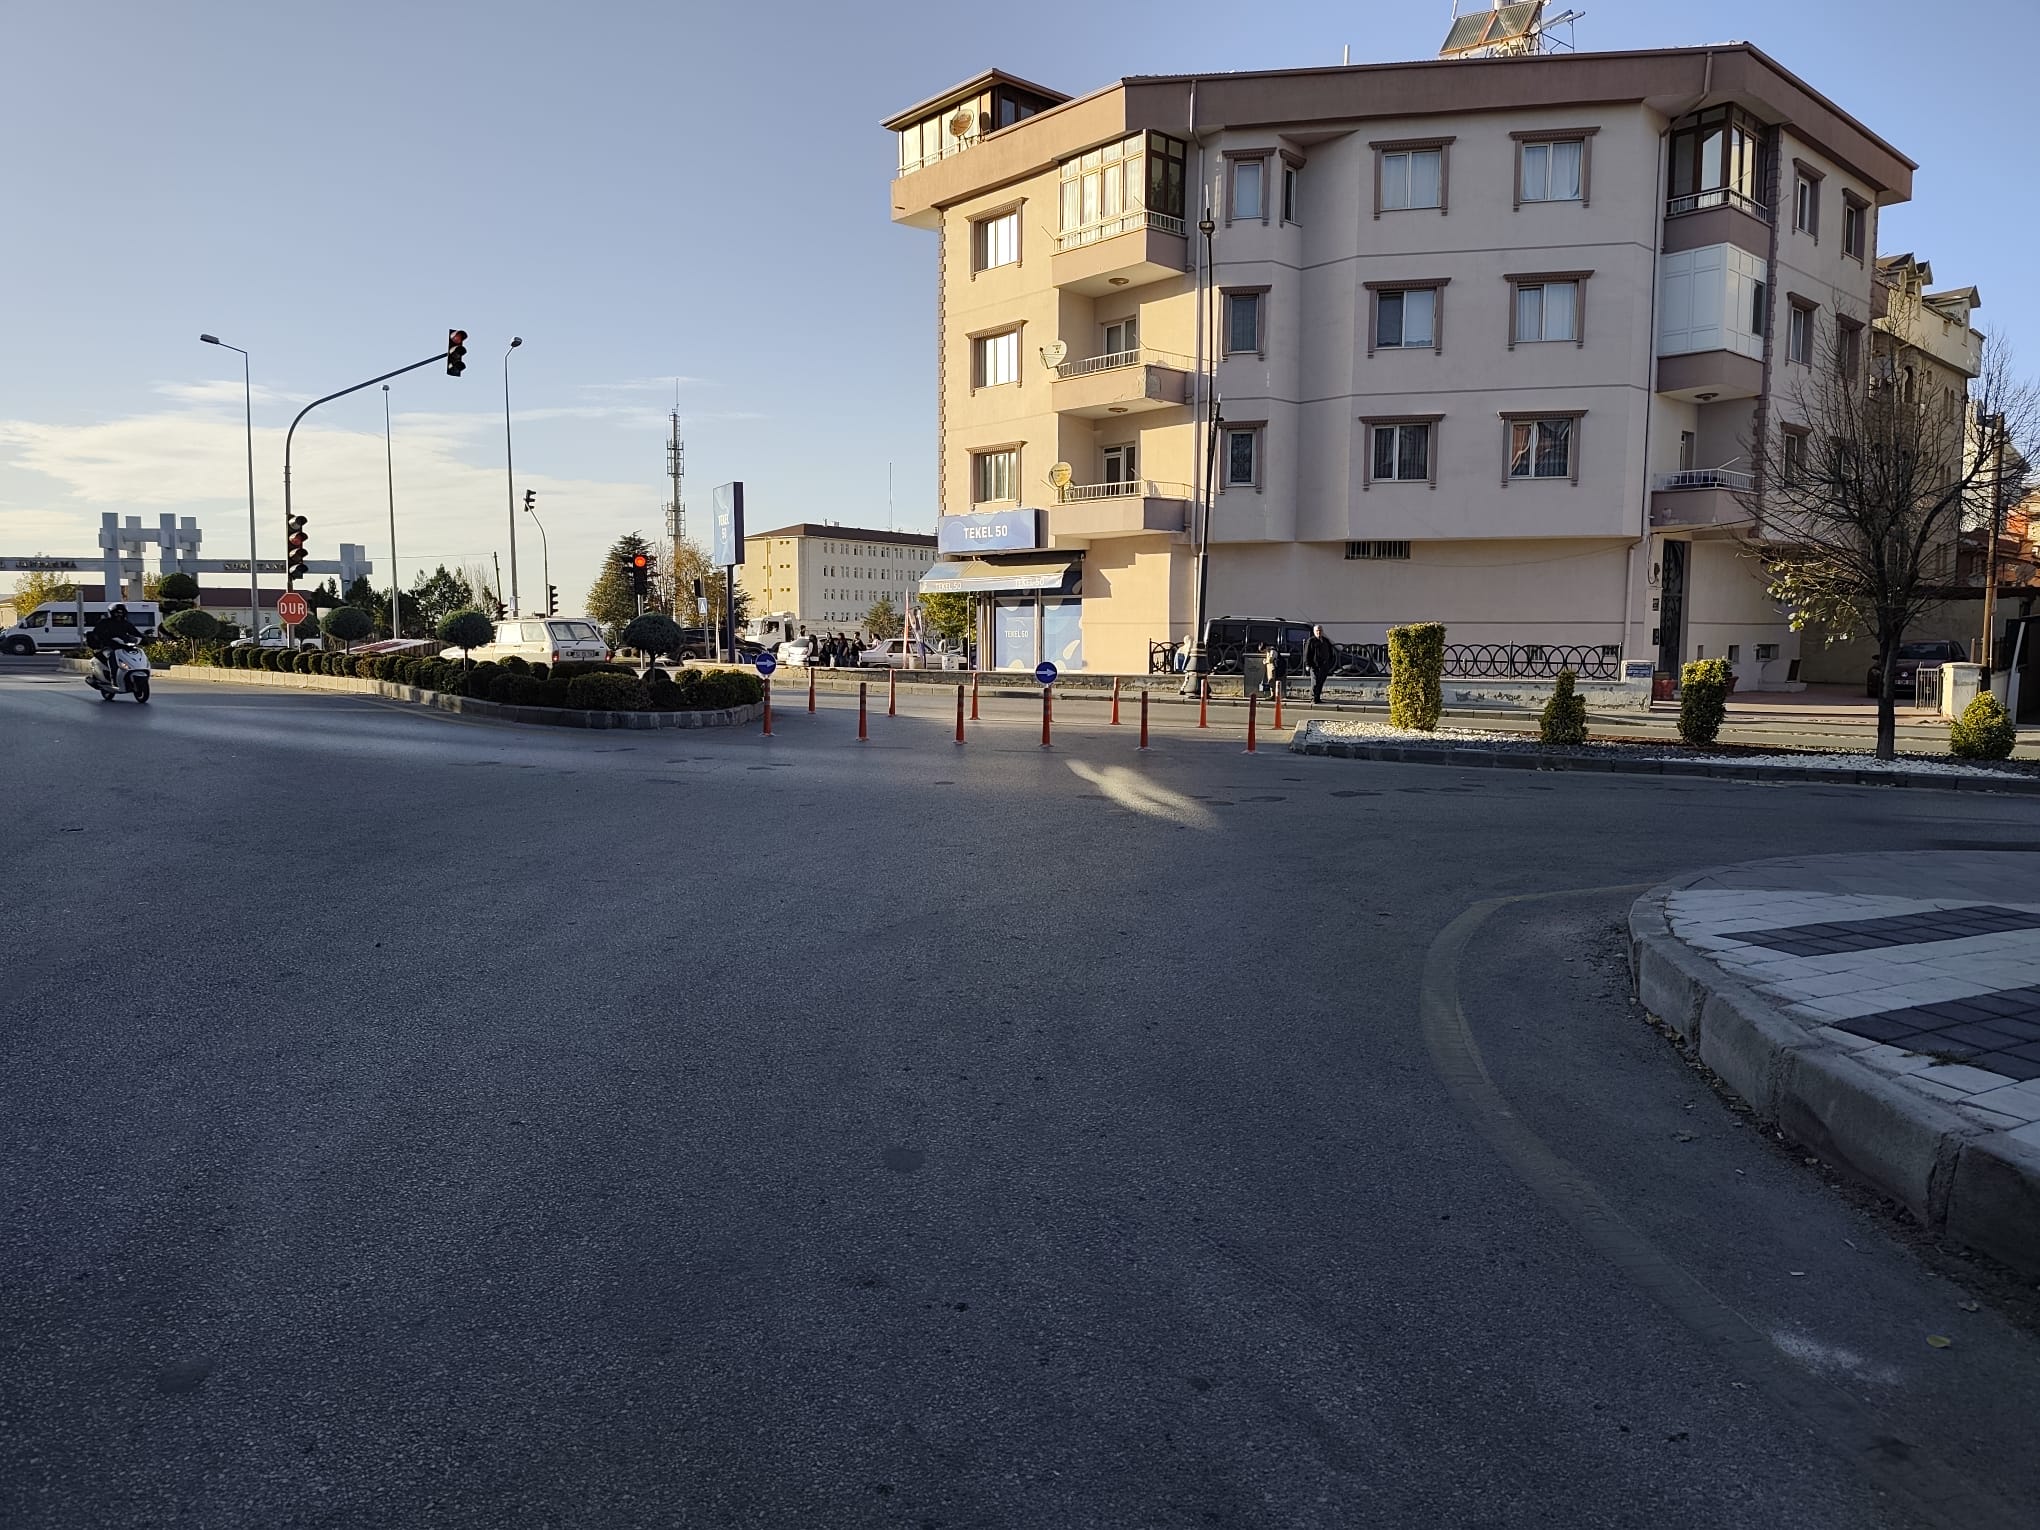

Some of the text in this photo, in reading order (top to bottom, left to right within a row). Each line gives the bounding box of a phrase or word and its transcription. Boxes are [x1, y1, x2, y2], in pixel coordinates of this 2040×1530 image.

[963, 525, 1008, 539] TEKEL 50
[935, 582, 953, 591] TEKEL
[280, 602, 305, 615] DUR
